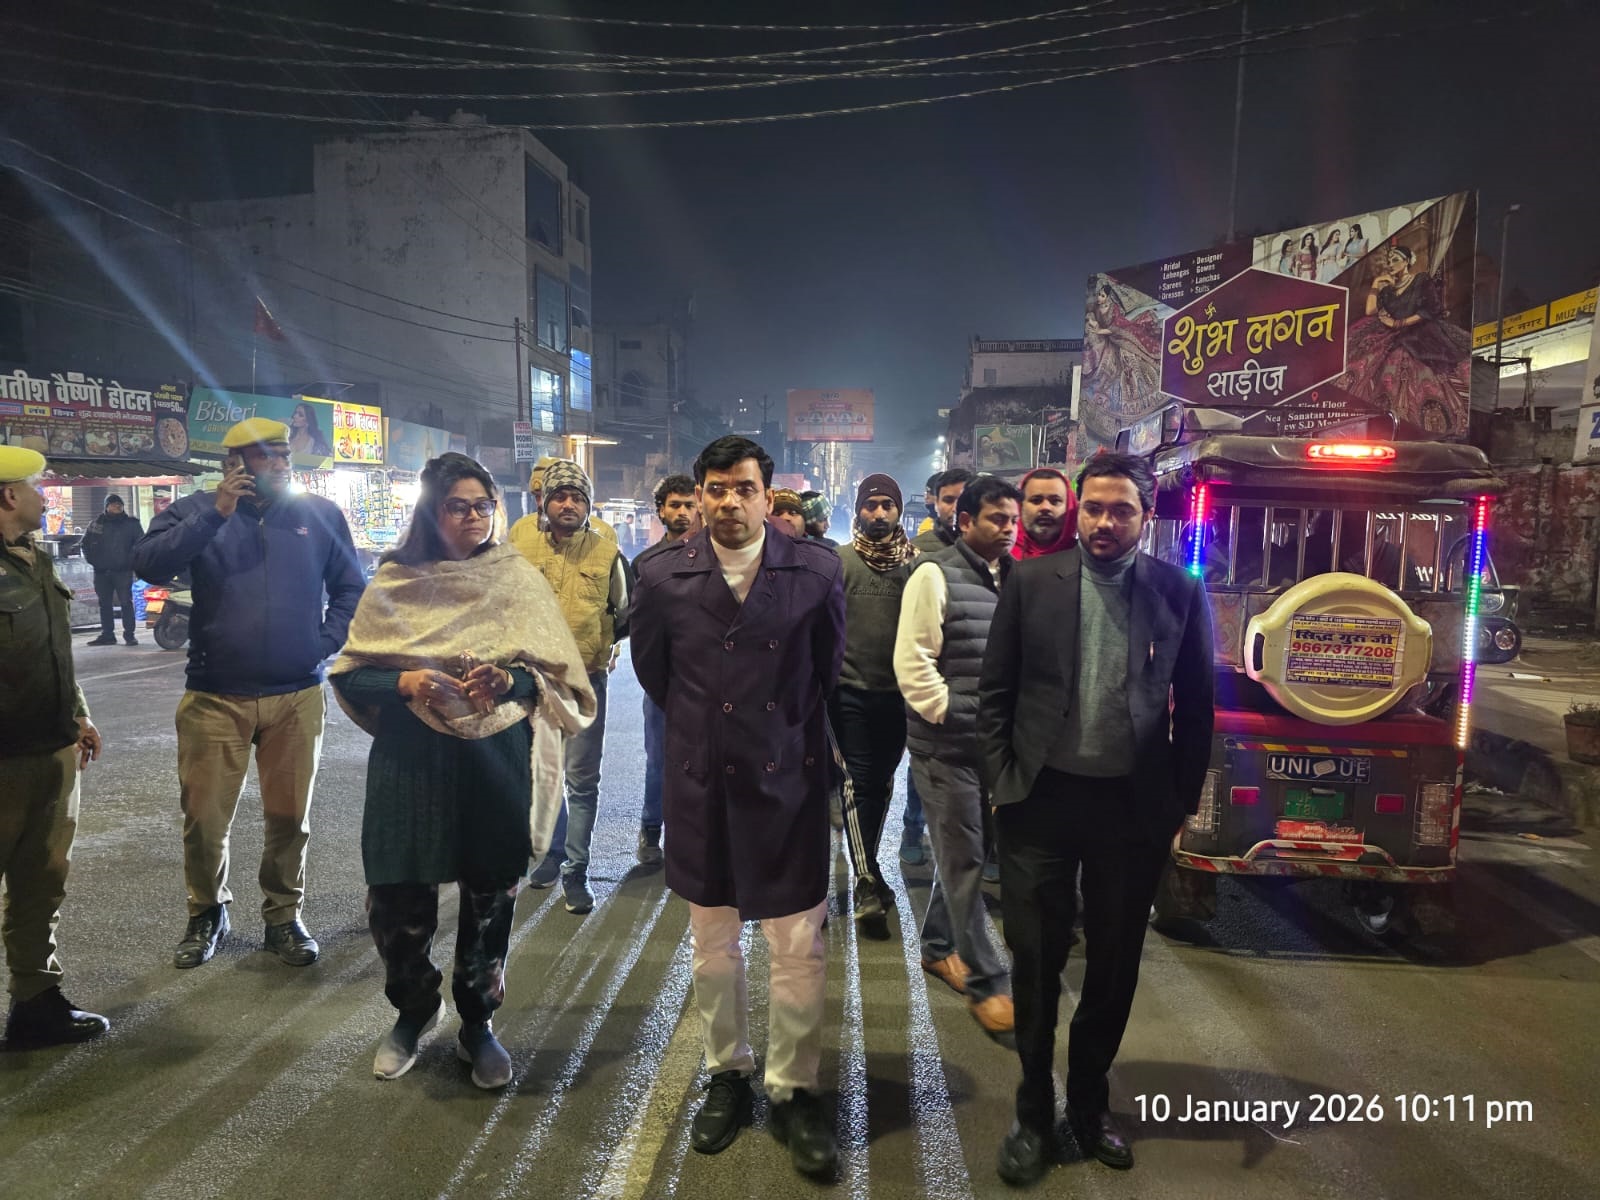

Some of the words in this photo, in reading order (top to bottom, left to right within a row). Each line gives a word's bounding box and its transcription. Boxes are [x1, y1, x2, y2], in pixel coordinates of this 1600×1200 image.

[1196, 253, 1223, 265] Designer
[1163, 261, 1181, 272] Bridal
[1196, 264, 1216, 274] Gowns
[1163, 269, 1190, 280] Lehengas
[1162, 282, 1182, 291] Sarees
[1194, 285, 1210, 294] Suits
[1161, 290, 1185, 300] Dresses
[1168, 316, 1239, 375] शुभ
[1247, 303, 1340, 354] लगन
[106, 380, 152, 412] होटल
[195, 400, 257, 421] Bisleri
[1322, 400, 1347, 409] Floor
[358, 407, 379, 430] होटल
[1265, 414, 1281, 423] Nea
[1288, 411, 1325, 421] Sanatan
[1370, 633, 1393, 645] जी
[1292, 641, 1394, 658] 9667377208
[1271, 756, 1367, 777] UNIUE
